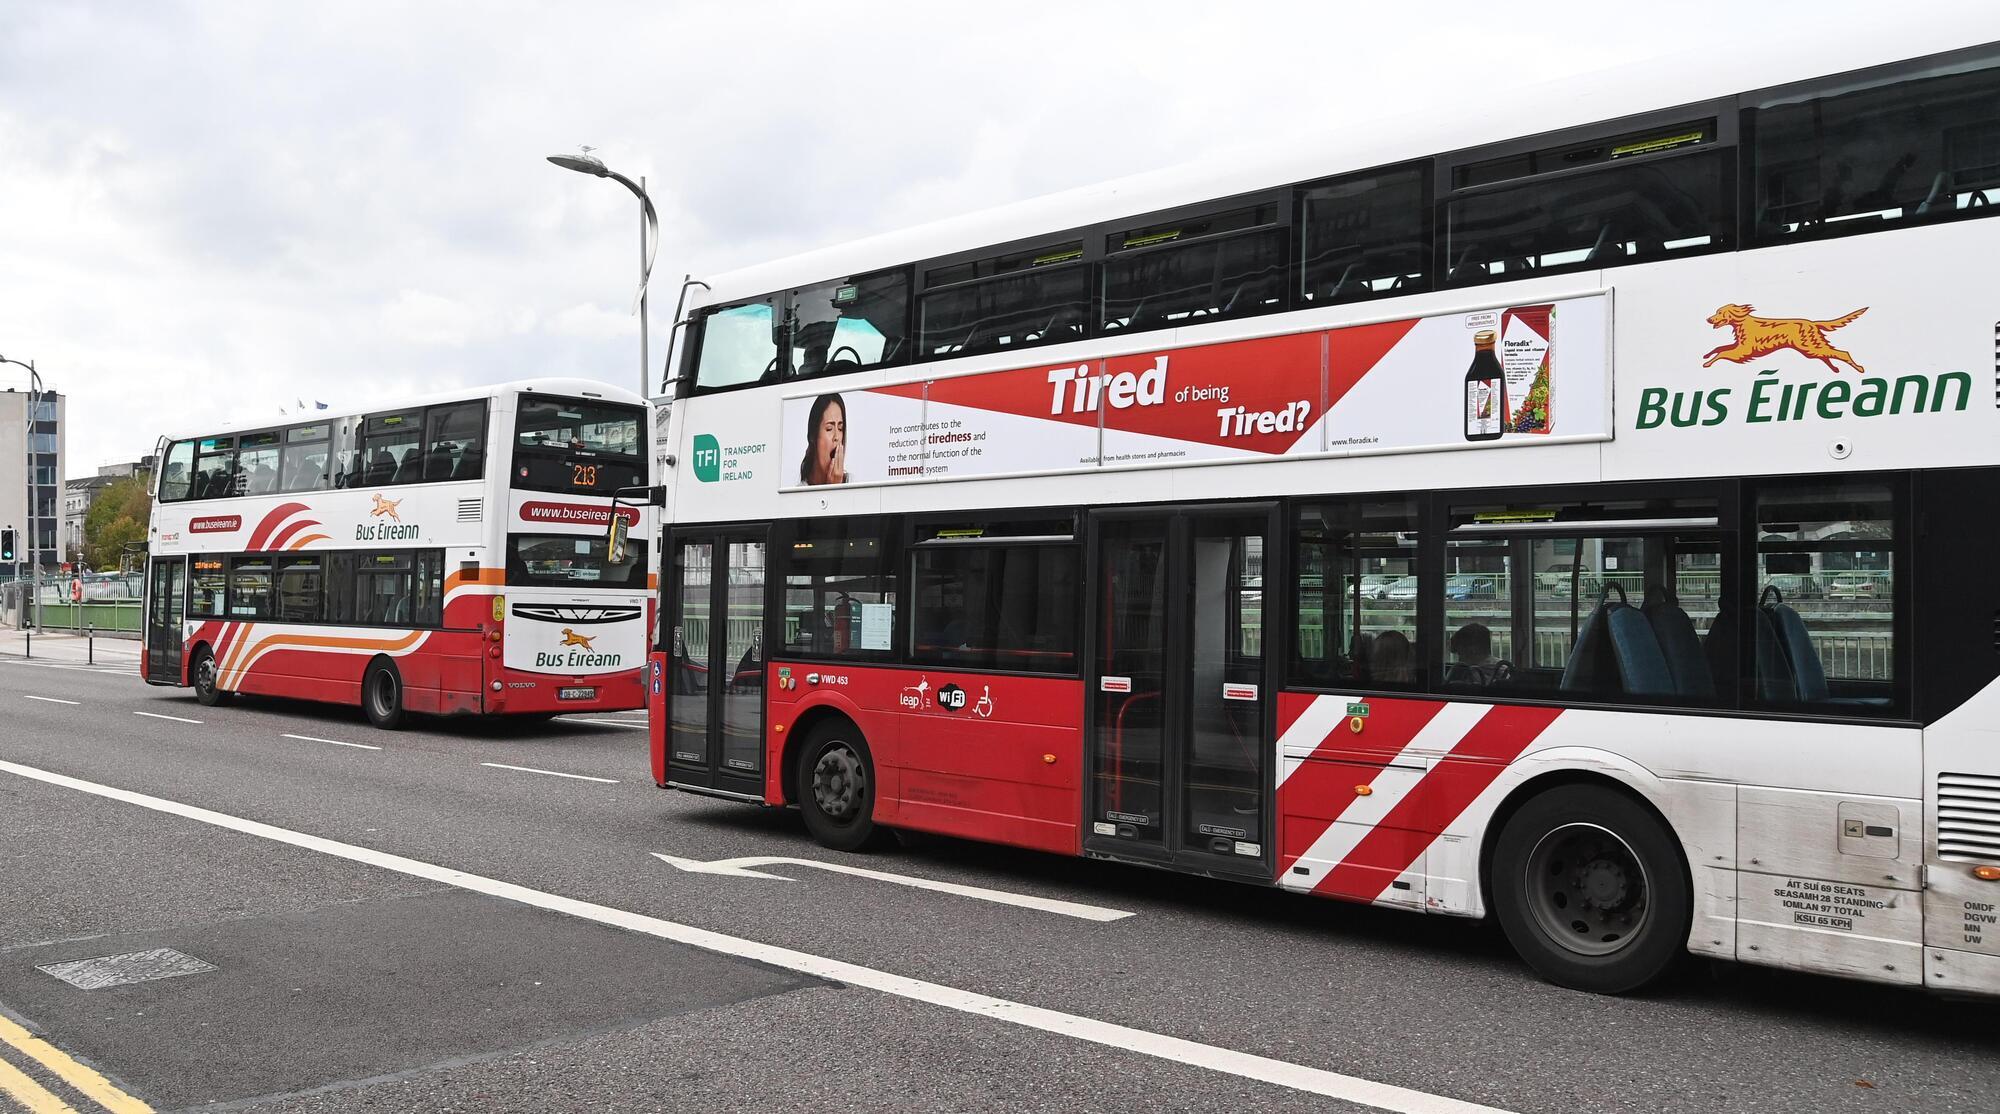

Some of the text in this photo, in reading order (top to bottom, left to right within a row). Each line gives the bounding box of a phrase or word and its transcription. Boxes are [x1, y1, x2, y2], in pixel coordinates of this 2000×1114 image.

[1047, 355, 1229, 415] Tired of being
[1635, 387, 1731, 430] Bus
[1217, 400, 1311, 437] Tired?
[889, 426, 902, 434] Iron
[903, 422, 939, 433] contributes
[950, 419, 961, 428] the
[888, 439, 918, 448] reduction
[928, 432, 971, 445] tiredness
[973, 431, 986, 441] and
[1331, 436, 1379, 446] www.floradix.ie
[724, 444, 766, 456] TRANSPORT
[896, 453, 907, 462] the
[908, 450, 930, 460] normal
[932, 449, 960, 459] function
[961, 447, 969, 456] of
[970, 447, 982, 456] the
[1157, 450, 1186, 459] pharmacies
[696, 449, 717, 467] TFI
[723, 460, 737, 468] FOR
[573, 464, 596, 485] 213
[722, 470, 753, 481] IRELAND
[888, 465, 948, 476] immune system
[531, 507, 631, 521] www.buseireaie
[192, 518, 238, 530] www.buseireann.ie
[355, 524, 375, 540] Bus
[535, 652, 564, 667] Bus
[821, 674, 849, 685] VWD 453
[900, 692, 919, 709] leap
[1786, 879, 1865, 897] ÁIT SUÍ 69 SEATS
[1774, 888, 1884, 909] SEASAMH 28 STANDING
[1782, 900, 1865, 918] IOMLAN 97 TOTAL
[1964, 901, 1995, 912] OMDF
[1796, 913, 1851, 928] KSU 65 KPH
[1964, 912, 1997, 924] DGVW
[1964, 923, 1981, 933] MN
[1964, 934, 1982, 944] UW
